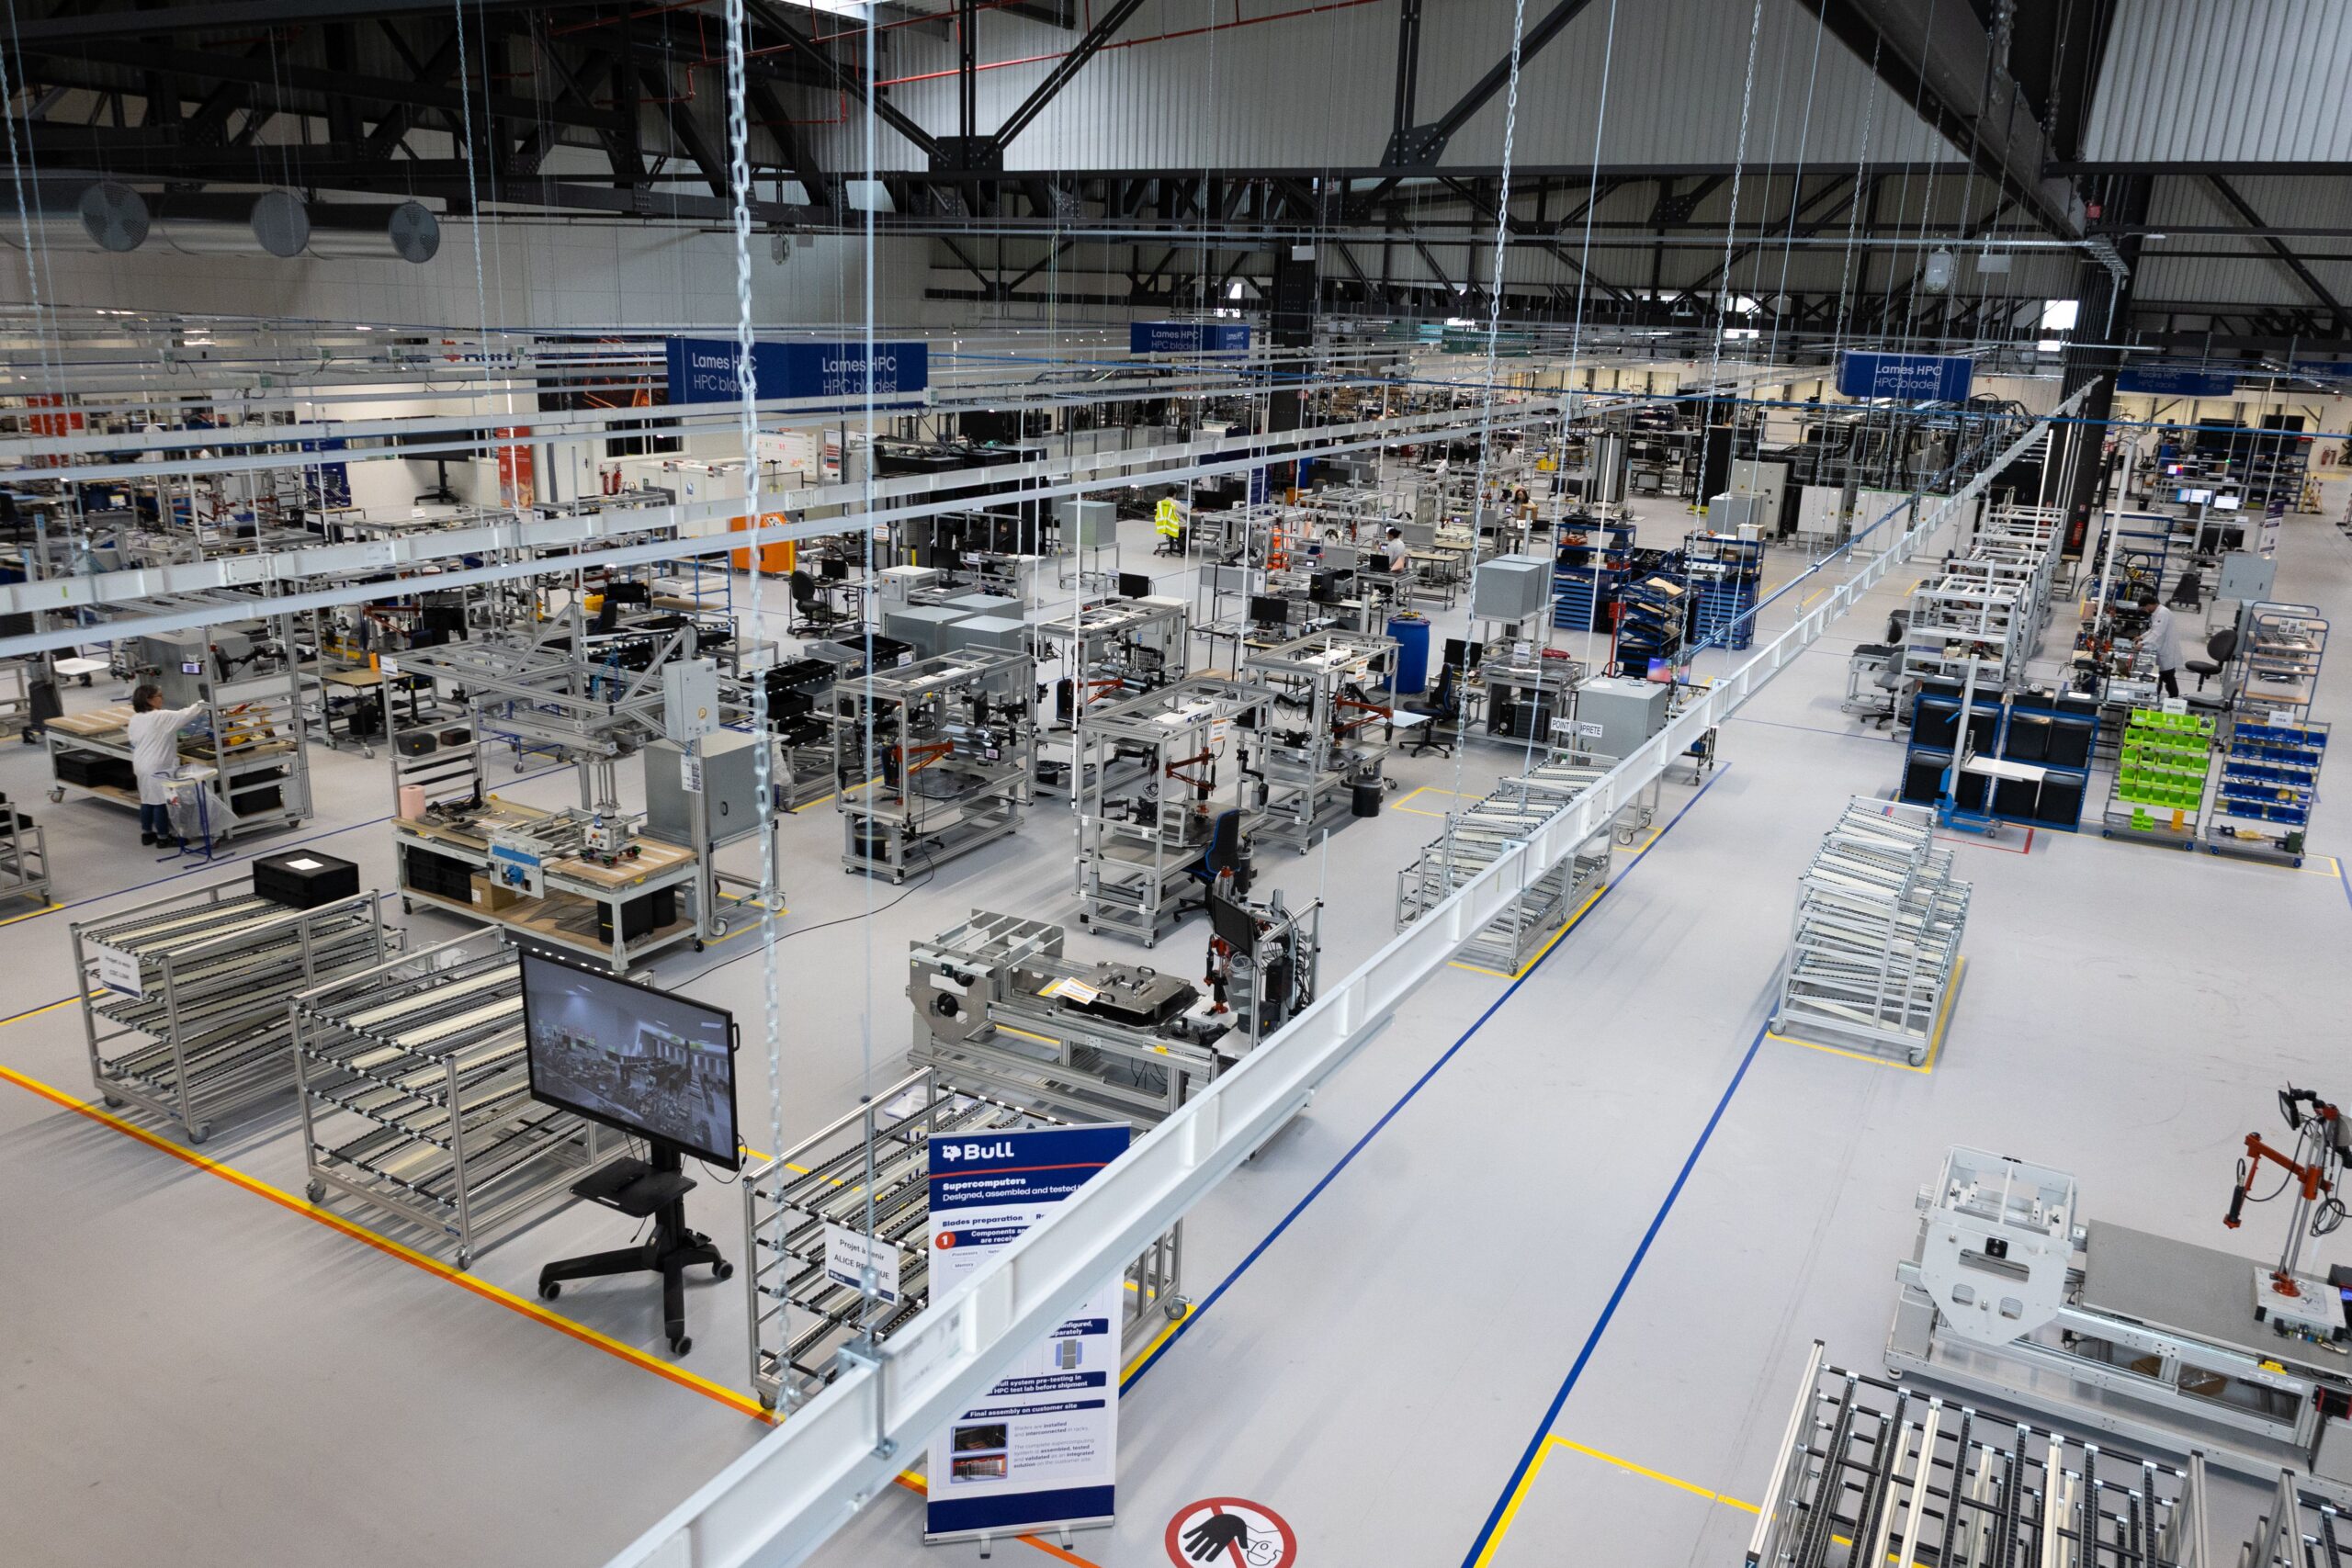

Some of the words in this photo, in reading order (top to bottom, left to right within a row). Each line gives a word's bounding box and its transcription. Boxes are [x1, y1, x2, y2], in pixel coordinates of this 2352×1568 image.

[1151, 329, 1180, 339] Lames
[1181, 331, 1199, 340] HPC
[1151, 340, 1169, 350] HPC
[693, 353, 729, 370] Lames
[732, 355, 757, 371] HC
[822, 356, 866, 373] Lames
[869, 356, 897, 371] HPC
[1876, 365, 1914, 376] Lames
[1917, 366, 1943, 377] HPC
[694, 375, 718, 391] HPC
[822, 378, 851, 395] HPC
[1874, 377, 1897, 389] HPC
[1553, 720, 1569, 730] POINT
[964, 1142, 1015, 1160] Bull
[943, 1178, 1026, 1191] Supercomputers
[943, 1190, 984, 1202] Designed,
[985, 1187, 1031, 1199] assembled
[1032, 1186, 1048, 1195] and
[1049, 1184, 1077, 1194] tested
[943, 1219, 970, 1228] Blades
[972, 1214, 1023, 1226] preparation
[971, 1227, 1016, 1238] Components
[840, 1238, 860, 1252] Projet
[942, 1235, 948, 1246] 1
[834, 1254, 854, 1269] ALICE
[1010, 1379, 1035, 1388] system
[1036, 1375, 1073, 1385] pre-testing
[1057, 1381, 1088, 1390] shipment
[988, 1407, 1021, 1416] assembly
[1032, 1404, 1063, 1413] customer
[1025, 1427, 1067, 1437] interconnected
[1066, 1450, 1094, 1458] integrated
